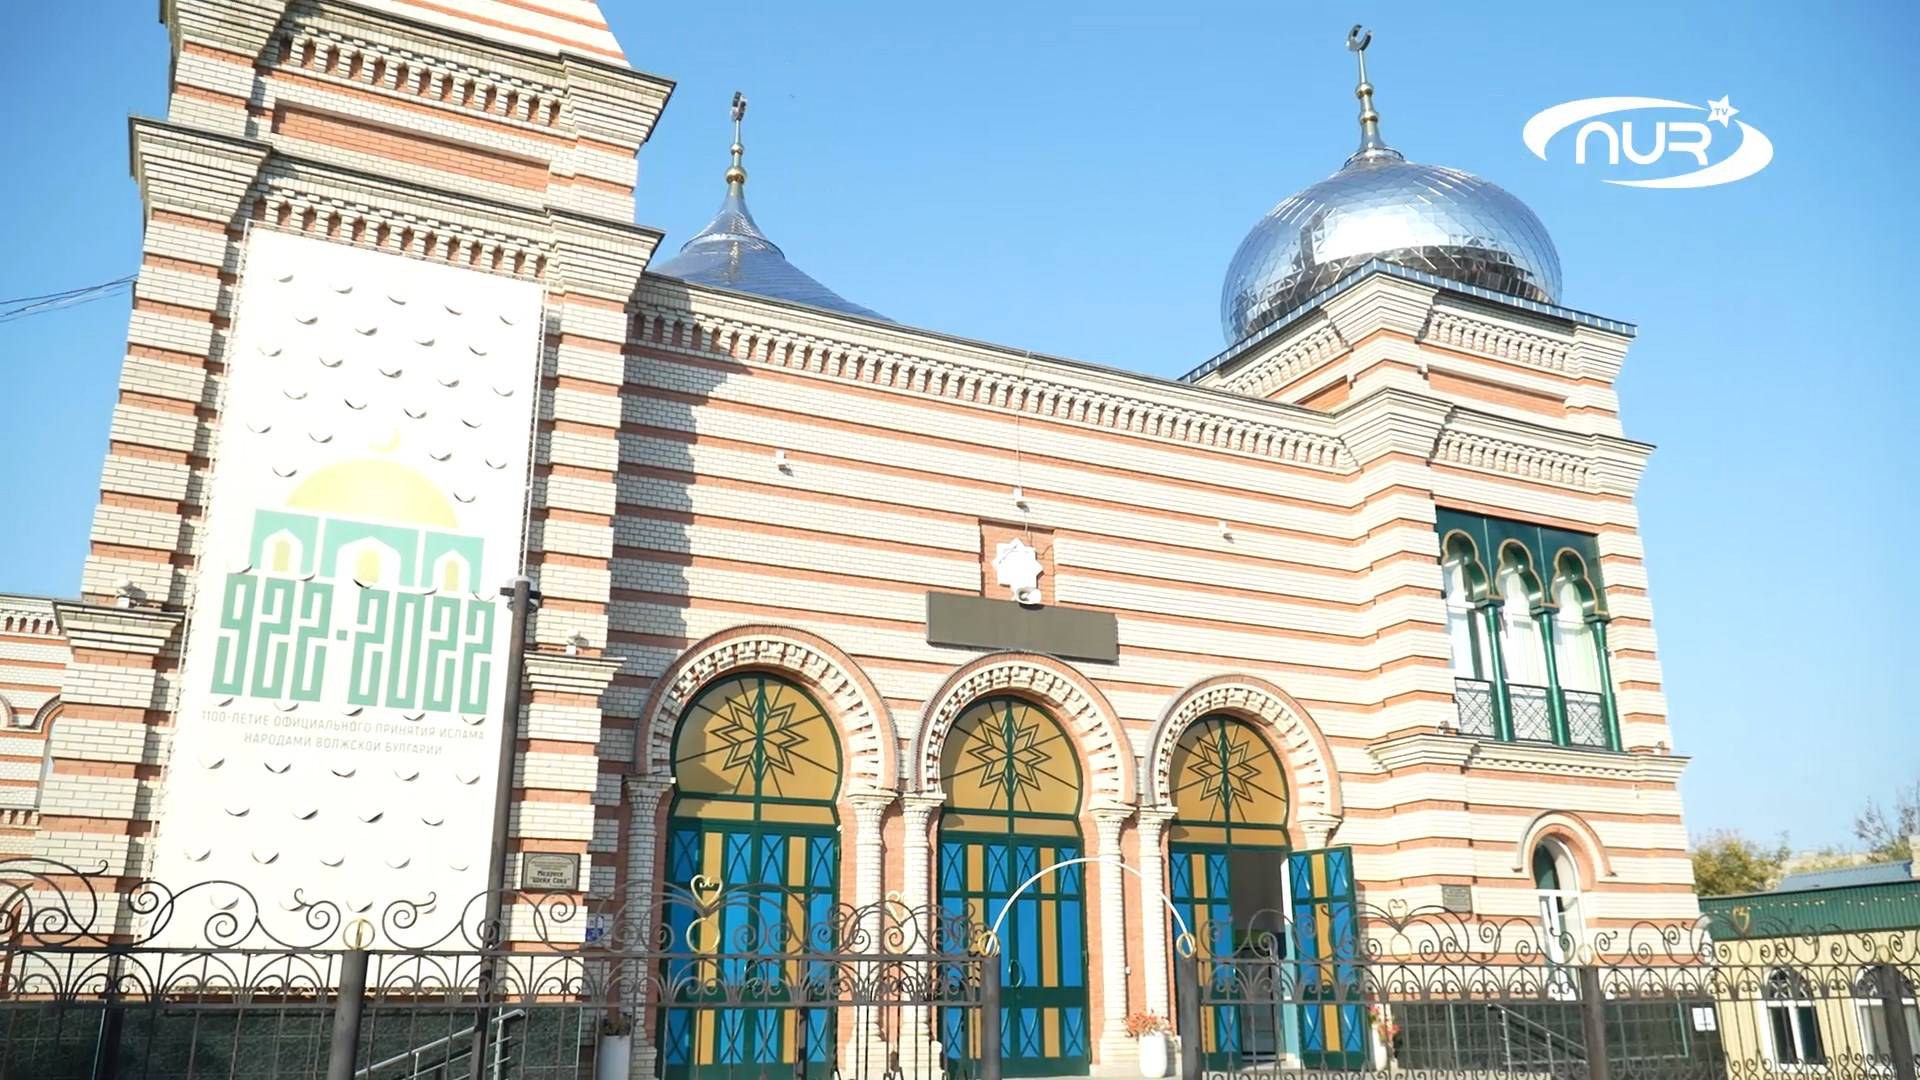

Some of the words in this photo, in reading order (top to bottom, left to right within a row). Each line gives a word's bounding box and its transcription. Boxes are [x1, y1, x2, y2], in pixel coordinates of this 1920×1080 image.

[201, 710, 269, 727] 1100-ЛЕТИЕ
[274, 714, 372, 734] ОФИЦИАЛЬНОГО
[375, 722, 436, 738] ПРИНЯТИЯ
[439, 726, 485, 741] ИСЛАМА
[244, 731, 312, 748] НАРОДАМИ
[385, 741, 443, 756] БУЛГАРИИ
